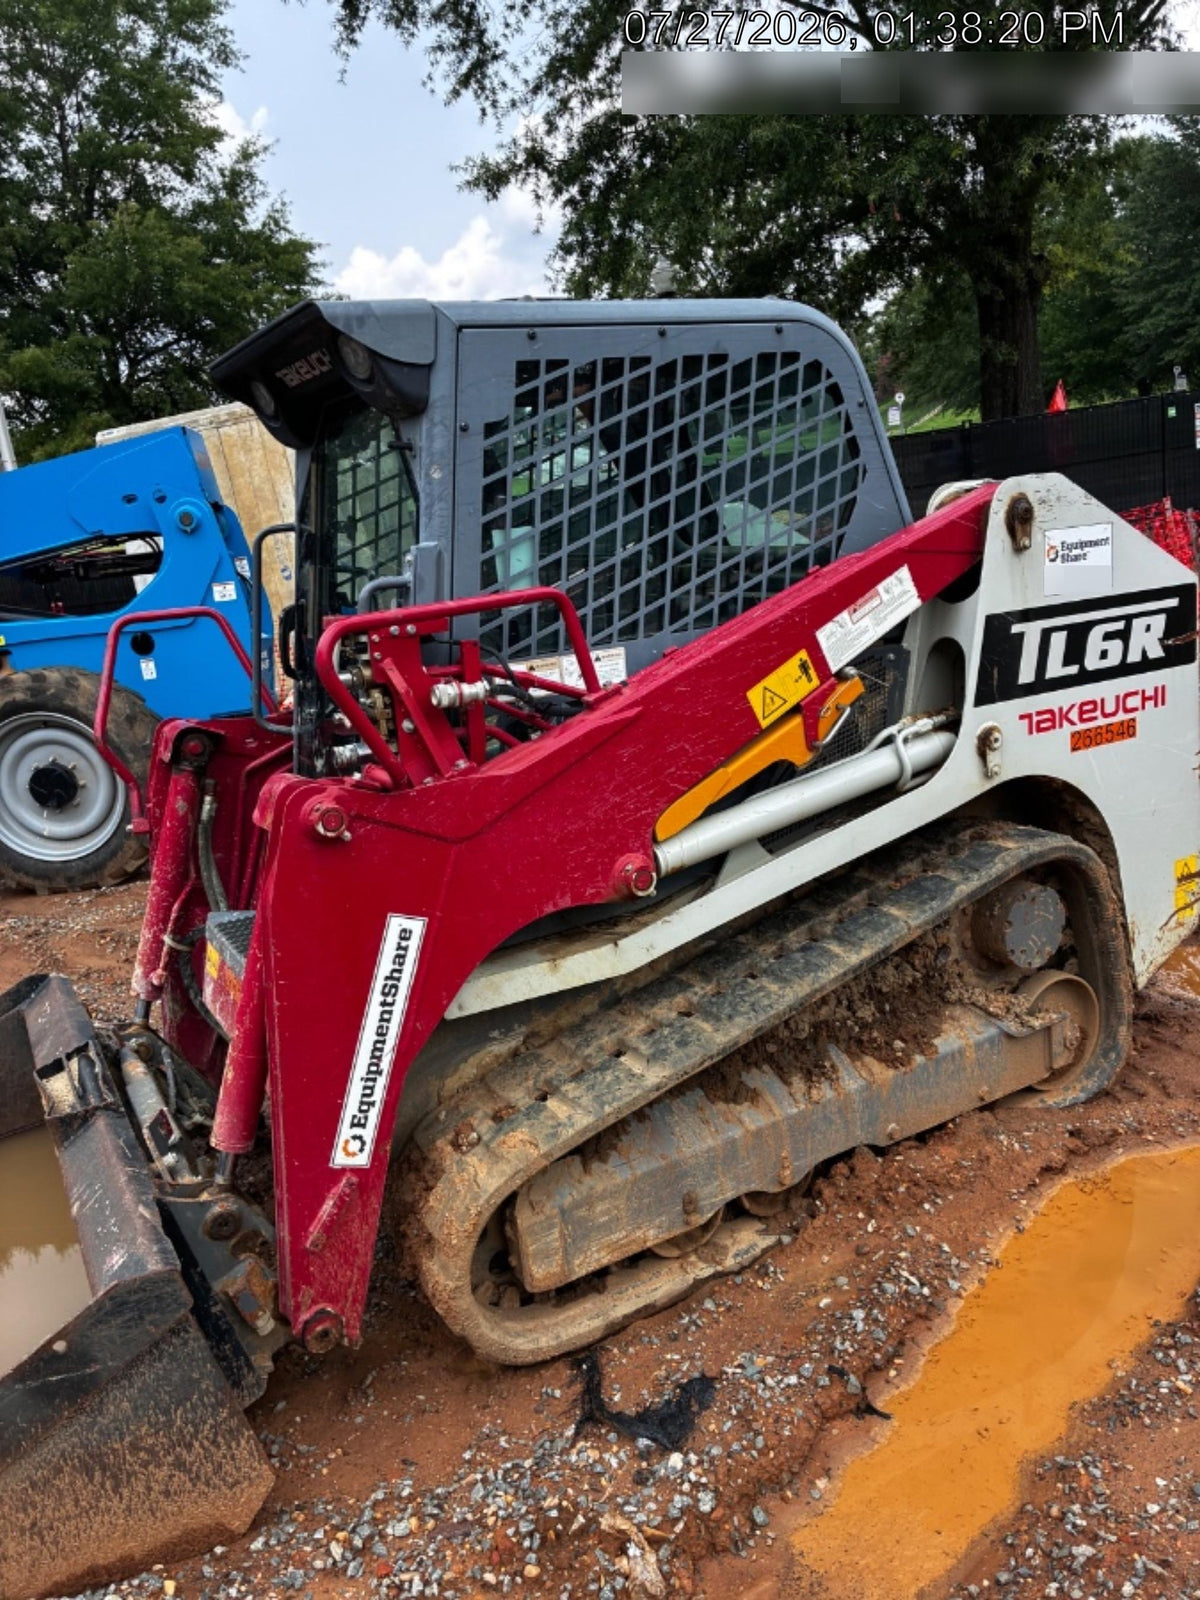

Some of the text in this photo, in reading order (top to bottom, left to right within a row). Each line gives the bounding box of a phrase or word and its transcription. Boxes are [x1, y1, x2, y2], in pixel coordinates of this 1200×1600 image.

[1060, 536, 1110, 553] Equipment
[1010, 597, 1180, 686] TL6R
[1071, 717, 1137, 752] 266546
[349, 926, 414, 1129] EquipmentShare
